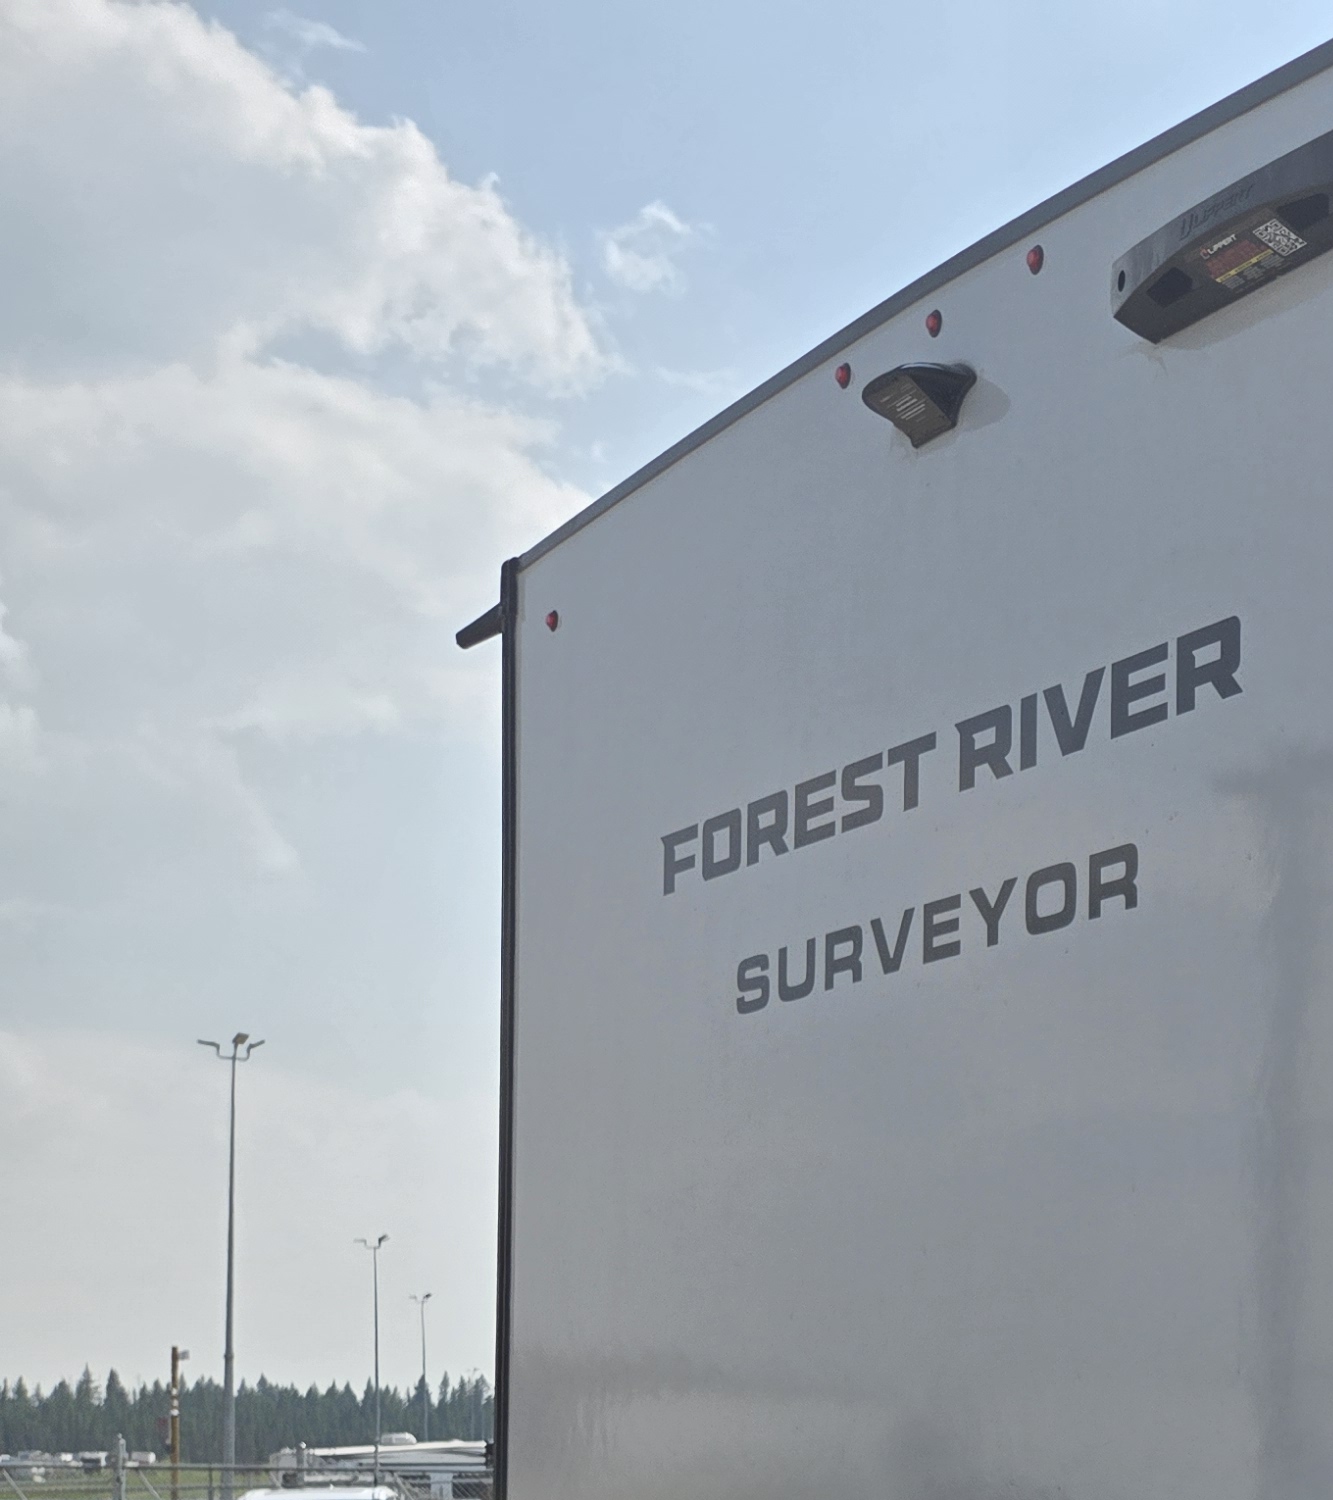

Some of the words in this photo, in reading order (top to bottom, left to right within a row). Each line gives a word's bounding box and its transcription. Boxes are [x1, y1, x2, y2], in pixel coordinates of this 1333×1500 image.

[660, 731, 936, 896] FOREST
[954, 616, 1243, 792] RIVER
[736, 843, 1138, 1015] SURVEYOR
